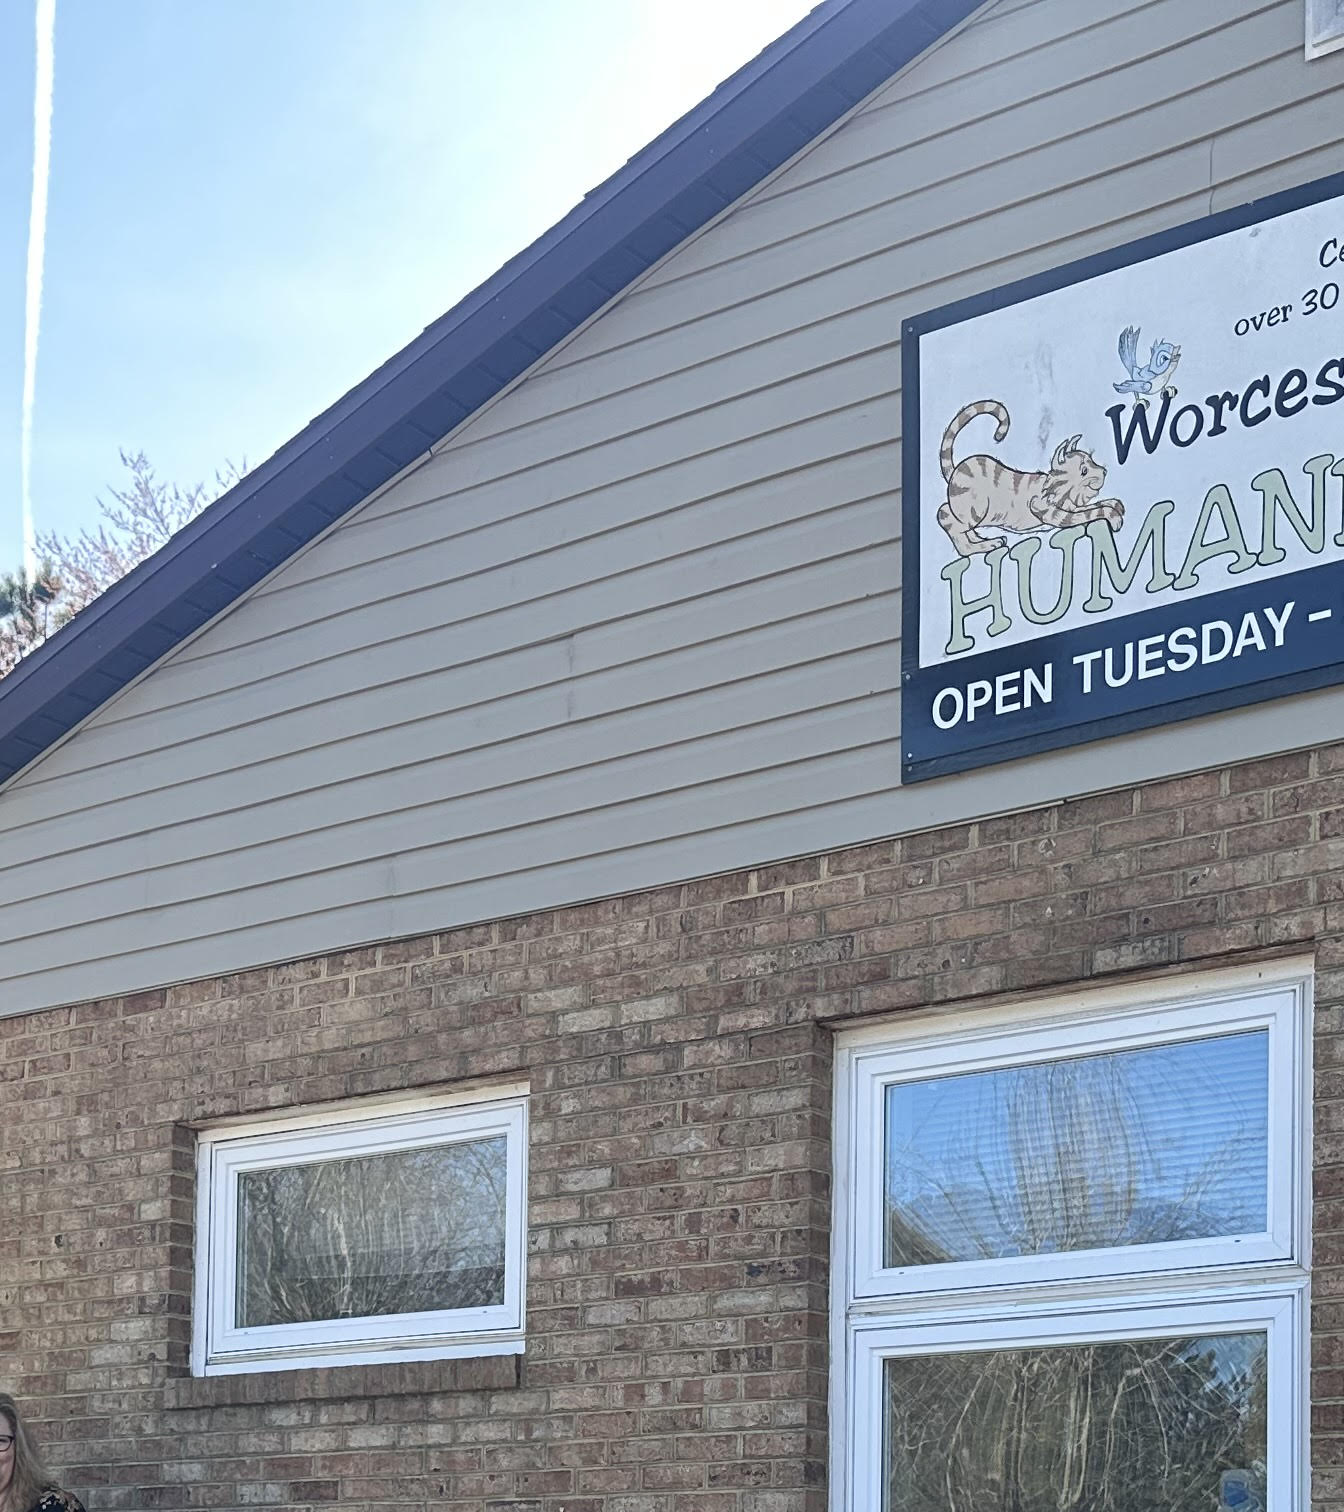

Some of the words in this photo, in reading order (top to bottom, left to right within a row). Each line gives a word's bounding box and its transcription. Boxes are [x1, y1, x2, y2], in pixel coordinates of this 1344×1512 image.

[1233, 302, 1293, 337] over
[1300, 282, 1340, 317] 30
[932, 662, 1054, 730] OPEN
[1073, 601, 1296, 695] TUESDAY
